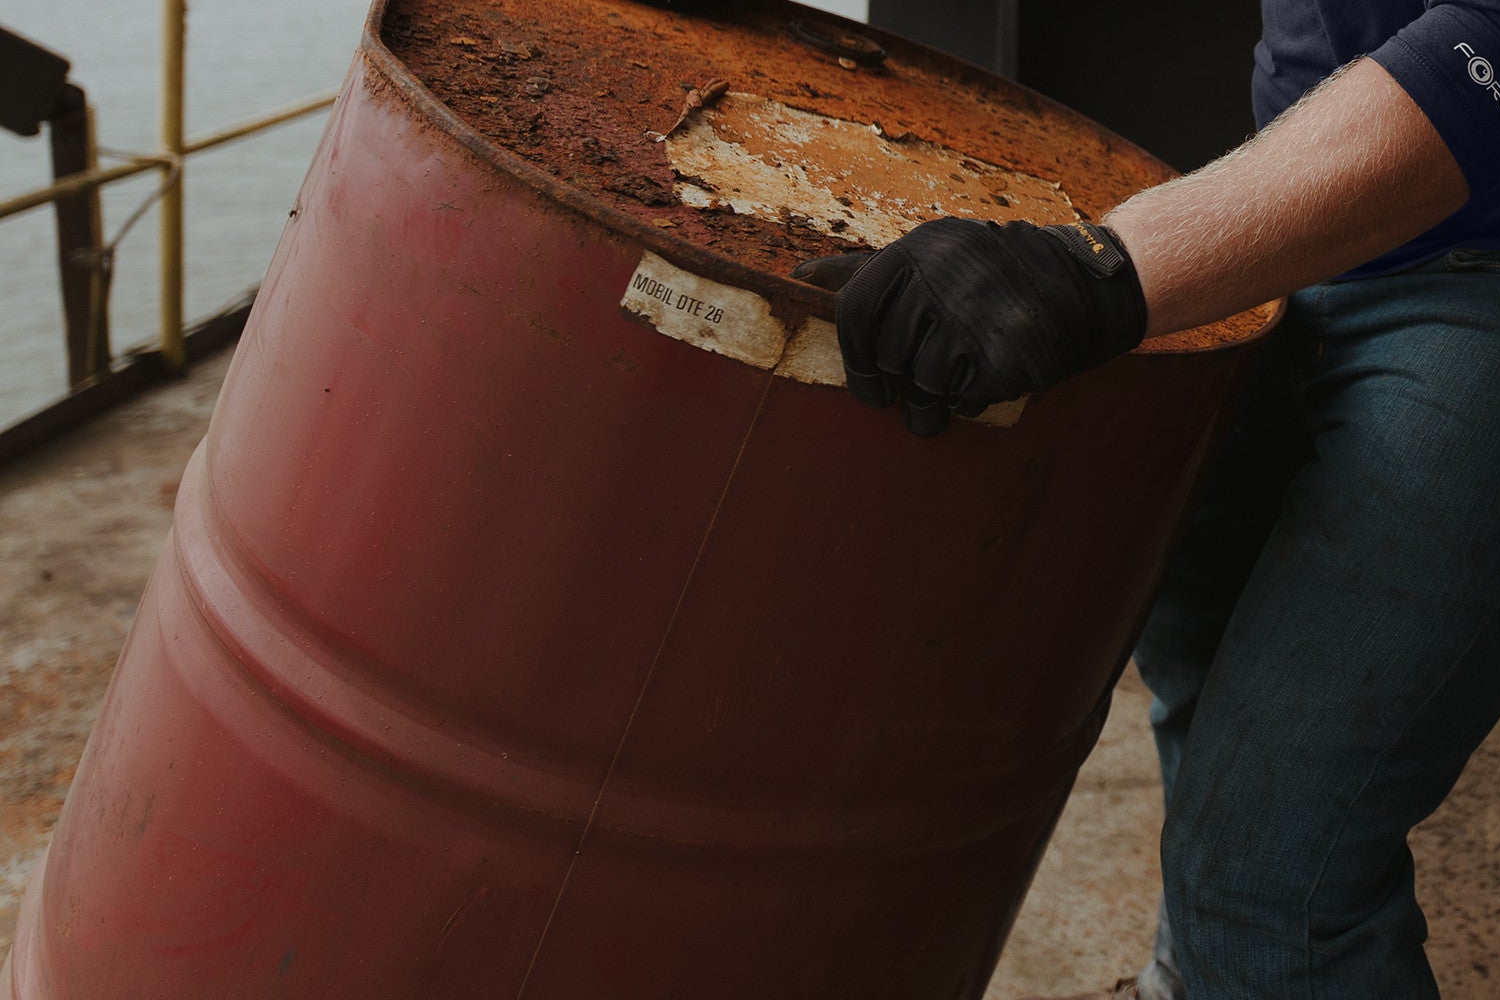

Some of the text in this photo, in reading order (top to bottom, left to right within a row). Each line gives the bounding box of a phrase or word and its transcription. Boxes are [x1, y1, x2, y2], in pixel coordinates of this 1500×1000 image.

[632, 273, 725, 324] MOBIL DTE 26
